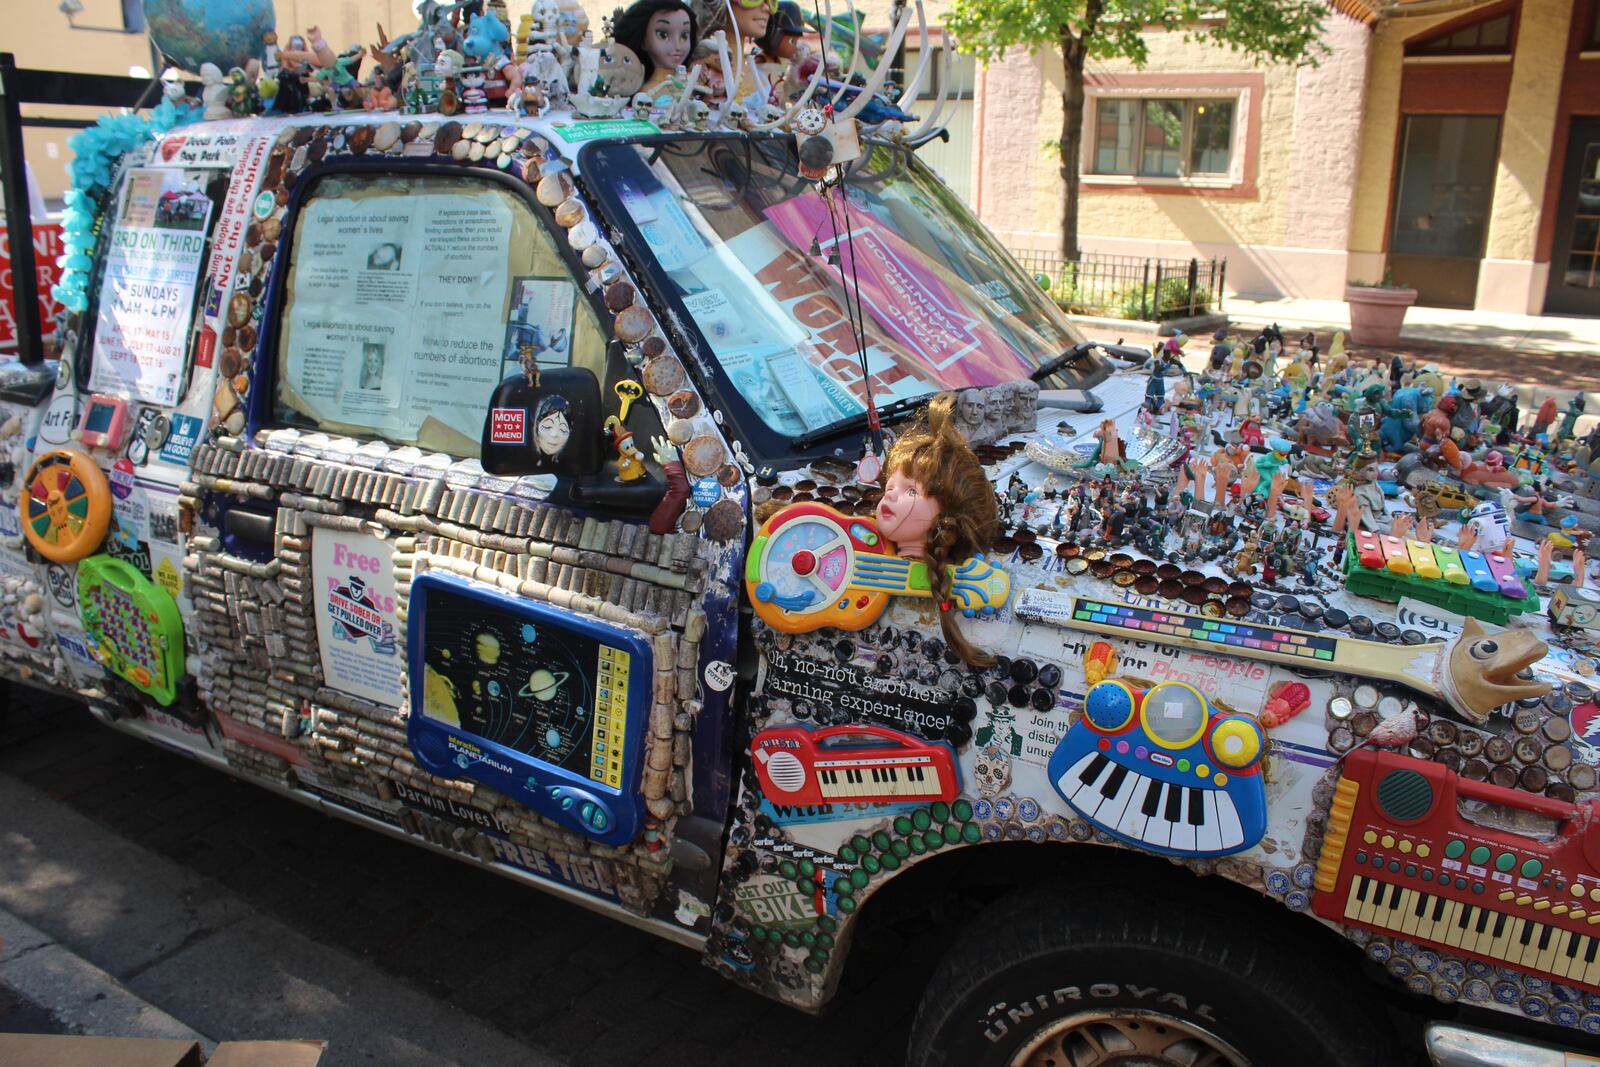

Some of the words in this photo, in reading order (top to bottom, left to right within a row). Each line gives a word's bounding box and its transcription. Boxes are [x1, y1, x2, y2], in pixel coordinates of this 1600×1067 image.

[235, 138, 256, 175] Solution
[230, 178, 241, 195] the
[218, 256, 234, 288] Not
[228, 220, 242, 249] the
[236, 136, 270, 214] Problem!
[225, 197, 236, 215] are
[369, 215, 387, 223] about
[213, 219, 229, 250] People
[369, 226, 384, 234] lives
[112, 231, 138, 248] 3RD
[140, 232, 157, 249] ON
[161, 233, 203, 253] THIRD
[438, 275, 457, 284] THEY
[863, 237, 965, 340] PARENTHOOD
[130, 284, 179, 302] SUNDAYS
[160, 305, 177, 318] PM
[884, 273, 958, 344] PLANNED
[888, 304, 942, 354] STAND
[906, 311, 949, 349] WITH
[451, 337, 477, 350] reduce
[480, 339, 494, 351] the
[413, 351, 447, 363] numbers
[448, 351, 457, 363] of
[821, 378, 857, 412] WOMEN
[44, 411, 60, 427] Art
[494, 413, 522, 423] MOVE
[170, 435, 195, 447] BELIEVE
[494, 431, 522, 440] AMEND
[171, 443, 191, 456] GOOD
[333, 542, 381, 575] Free
[51, 570, 70, 590] BIG
[327, 576, 394, 613] Bks
[328, 602, 340, 616] GET
[340, 609, 364, 628] PULLED
[364, 620, 382, 636] OVER
[330, 592, 348, 610] DRIVE
[349, 602, 371, 621] SOBER
[371, 613, 381, 626] OR
[766, 649, 789, 673] Oh,
[794, 659, 857, 685] no-not
[1151, 660, 1218, 693] Profit
[766, 667, 834, 708] larning
[840, 694, 952, 731] experience!
[1030, 714, 1054, 729] Join
[1058, 718, 1070, 732] th
[448, 735, 481, 753] Interactive
[1027, 730, 1060, 745] dista
[448, 741, 513, 775] PLANETARIUM
[1026, 744, 1052, 759] unus
[397, 782, 446, 812] Darwin
[450, 799, 491, 828] Loves
[494, 834, 551, 876] FREE
[773, 843, 794, 852] serfas
[793, 849, 814, 858] serfas
[812, 855, 834, 864] serfas
[735, 884, 761, 899] GET
[762, 880, 791, 896] OUT
[751, 894, 819, 924] BIKE
[984, 983, 1217, 1043] UNIROYAL
